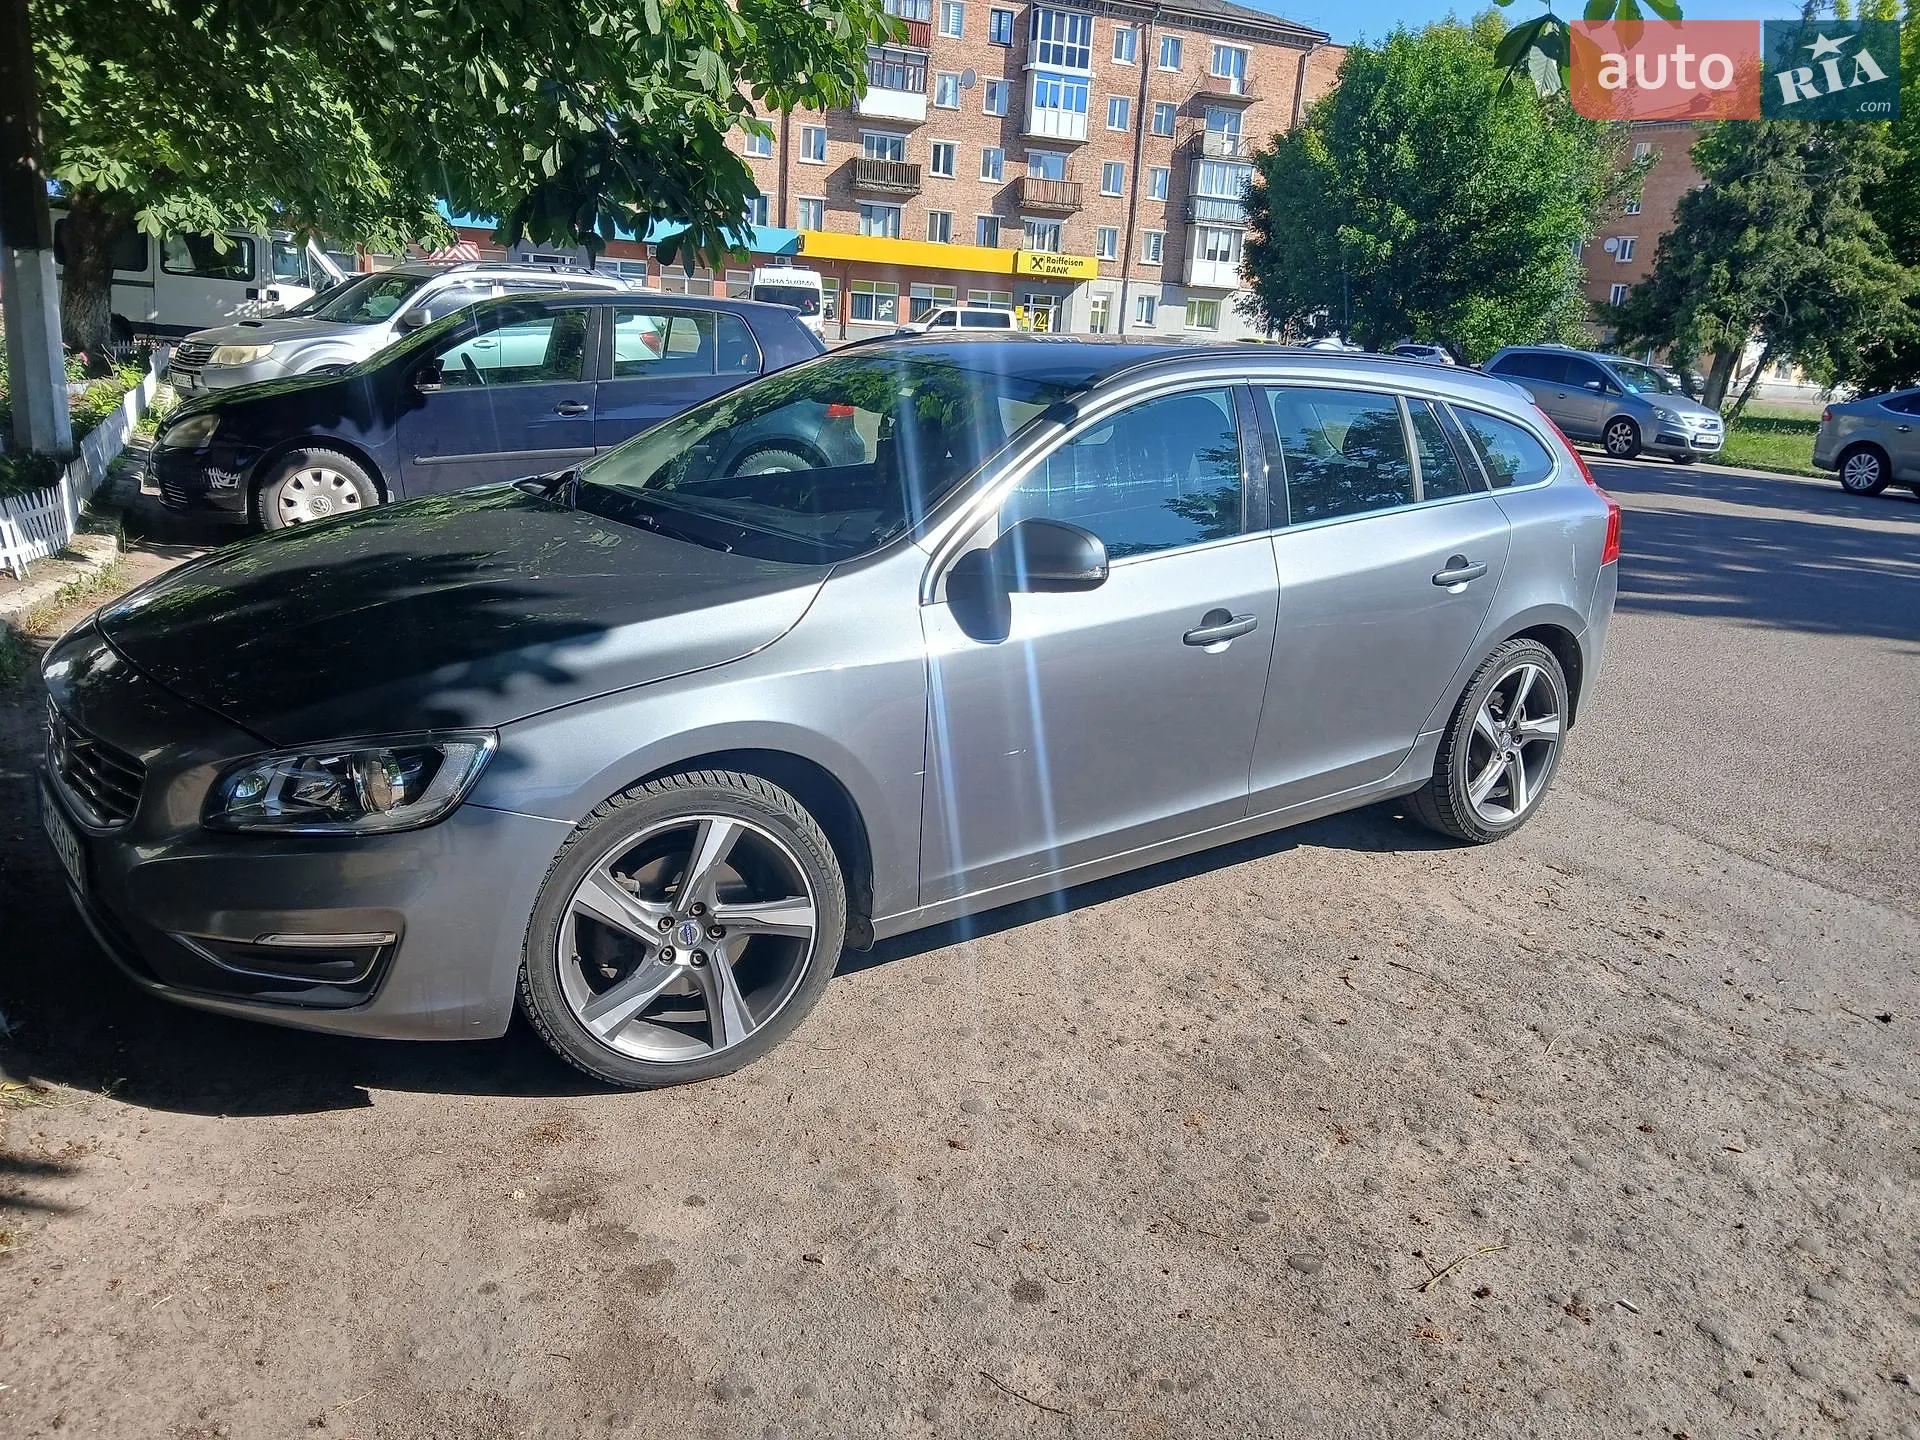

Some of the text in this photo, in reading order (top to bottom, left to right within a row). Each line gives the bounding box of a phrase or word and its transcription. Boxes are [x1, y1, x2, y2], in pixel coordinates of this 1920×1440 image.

[1046, 256, 1084, 267] Raiffeisen
[1046, 266, 1069, 275] BANK
[1033, 311, 1049, 332] 24
